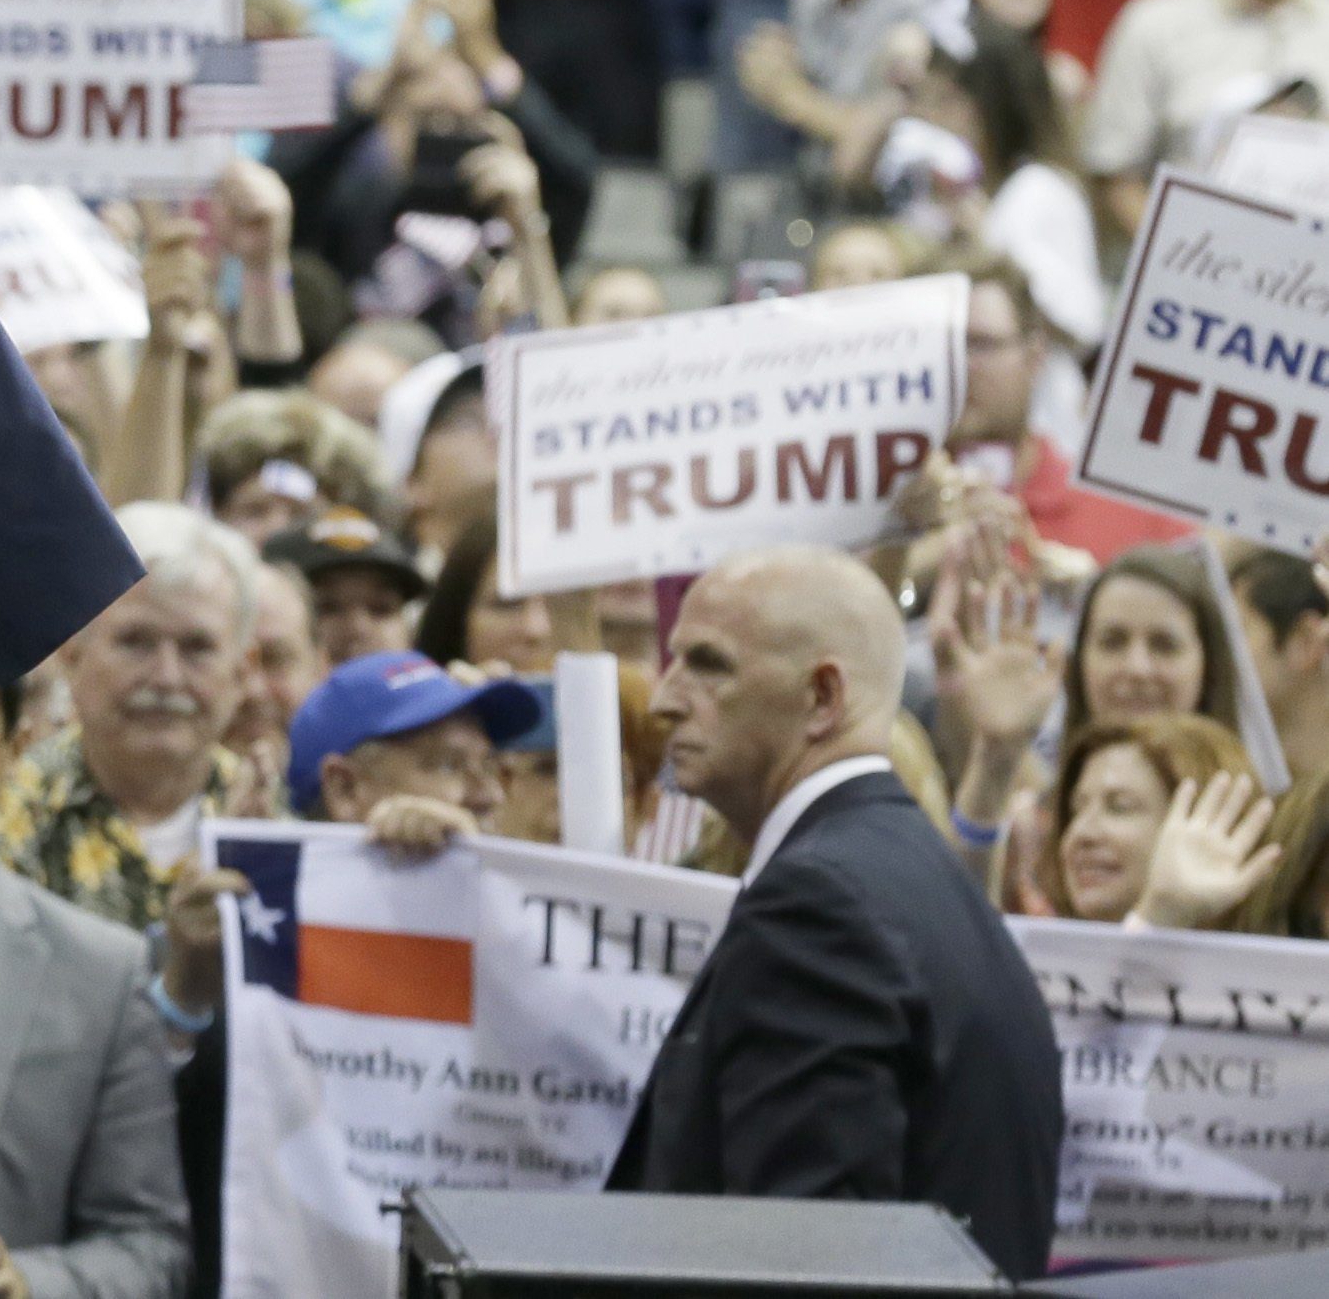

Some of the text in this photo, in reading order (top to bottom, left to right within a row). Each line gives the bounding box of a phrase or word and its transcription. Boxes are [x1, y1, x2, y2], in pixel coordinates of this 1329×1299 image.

[1159, 231, 1329, 319] the sile
[533, 365, 935, 458] STANDS WITH
[531, 429, 933, 535] TRUMP
[523, 893, 711, 985] THE
[441, 1057, 520, 1096] Ann
[1069, 1046, 1279, 1101] BRANCE
[346, 1125, 425, 1156] Killed
[431, 1132, 465, 1167] by
